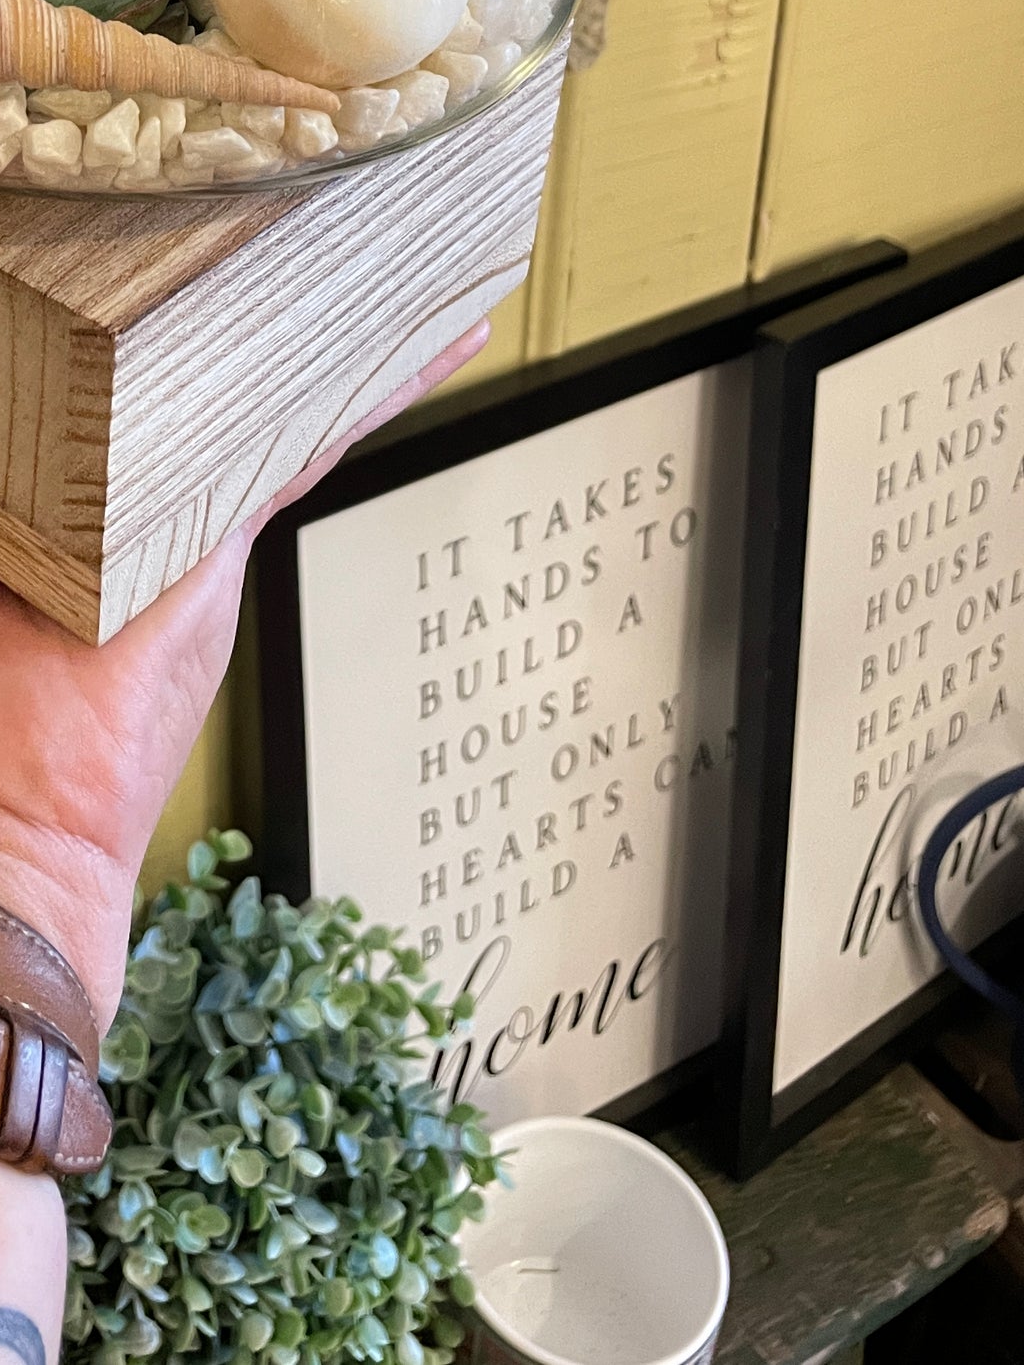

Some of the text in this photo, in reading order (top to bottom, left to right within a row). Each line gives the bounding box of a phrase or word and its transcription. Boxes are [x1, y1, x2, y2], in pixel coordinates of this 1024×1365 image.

[874, 404, 1008, 505] HANDS
[879, 342, 1018, 444] IT TAK
[417, 452, 676, 591] IT TAKES
[418, 506, 697, 655] HANDS TO
[865, 531, 992, 632] HOUSE
[870, 475, 990, 570] BUILD
[418, 591, 643, 720] BUILD A
[856, 633, 1006, 753] HEARTS
[860, 568, 1024, 694] BUT ONL
[419, 675, 592, 785] HOUSE
[419, 692, 680, 847] BUT ONLY
[851, 686, 1009, 809] BUILD A
[419, 779, 623, 908] HEARTS
[421, 832, 636, 960] BUILD A
[428, 935, 674, 1105] home
